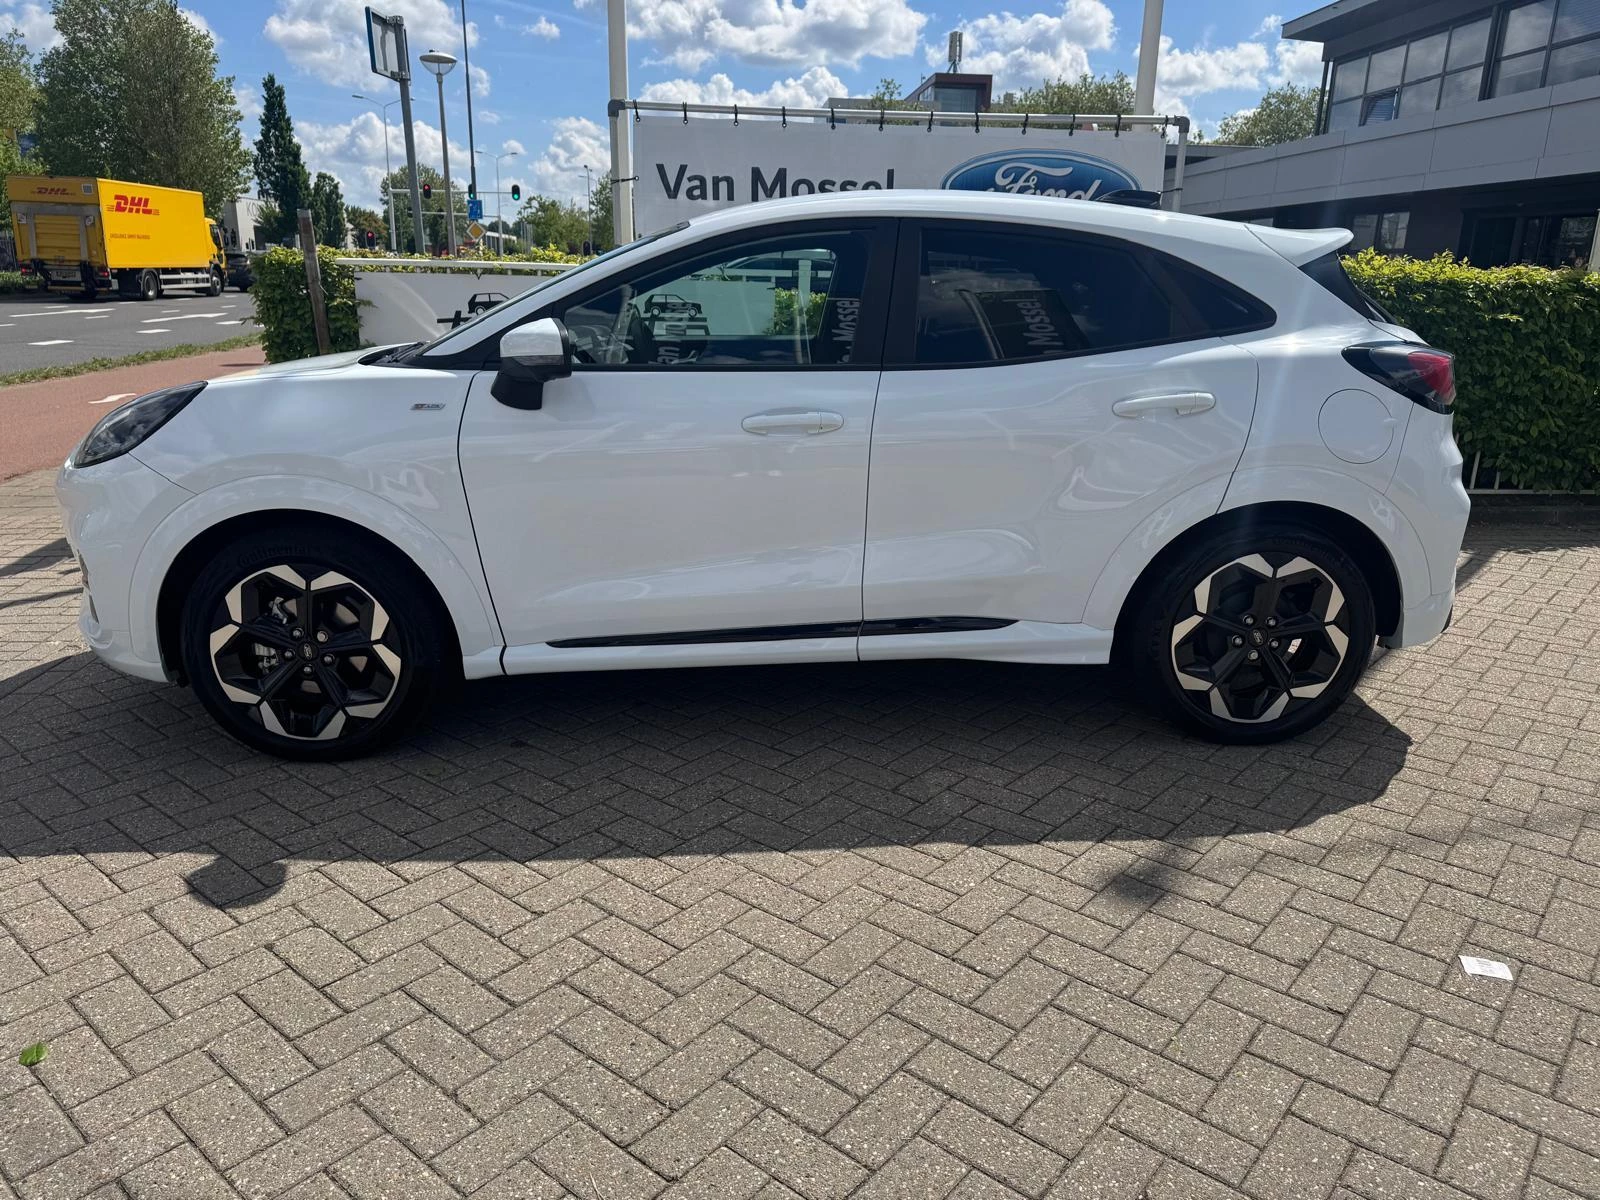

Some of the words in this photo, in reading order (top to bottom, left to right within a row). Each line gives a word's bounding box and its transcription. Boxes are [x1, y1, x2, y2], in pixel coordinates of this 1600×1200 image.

[35, 186, 69, 196] DHL
[655, 163, 735, 201] Van
[751, 166, 895, 202] Mosl
[994, 162, 1103, 201] Fd
[113, 194, 153, 215] DHL
[1003, 299, 1065, 346] Mossel
